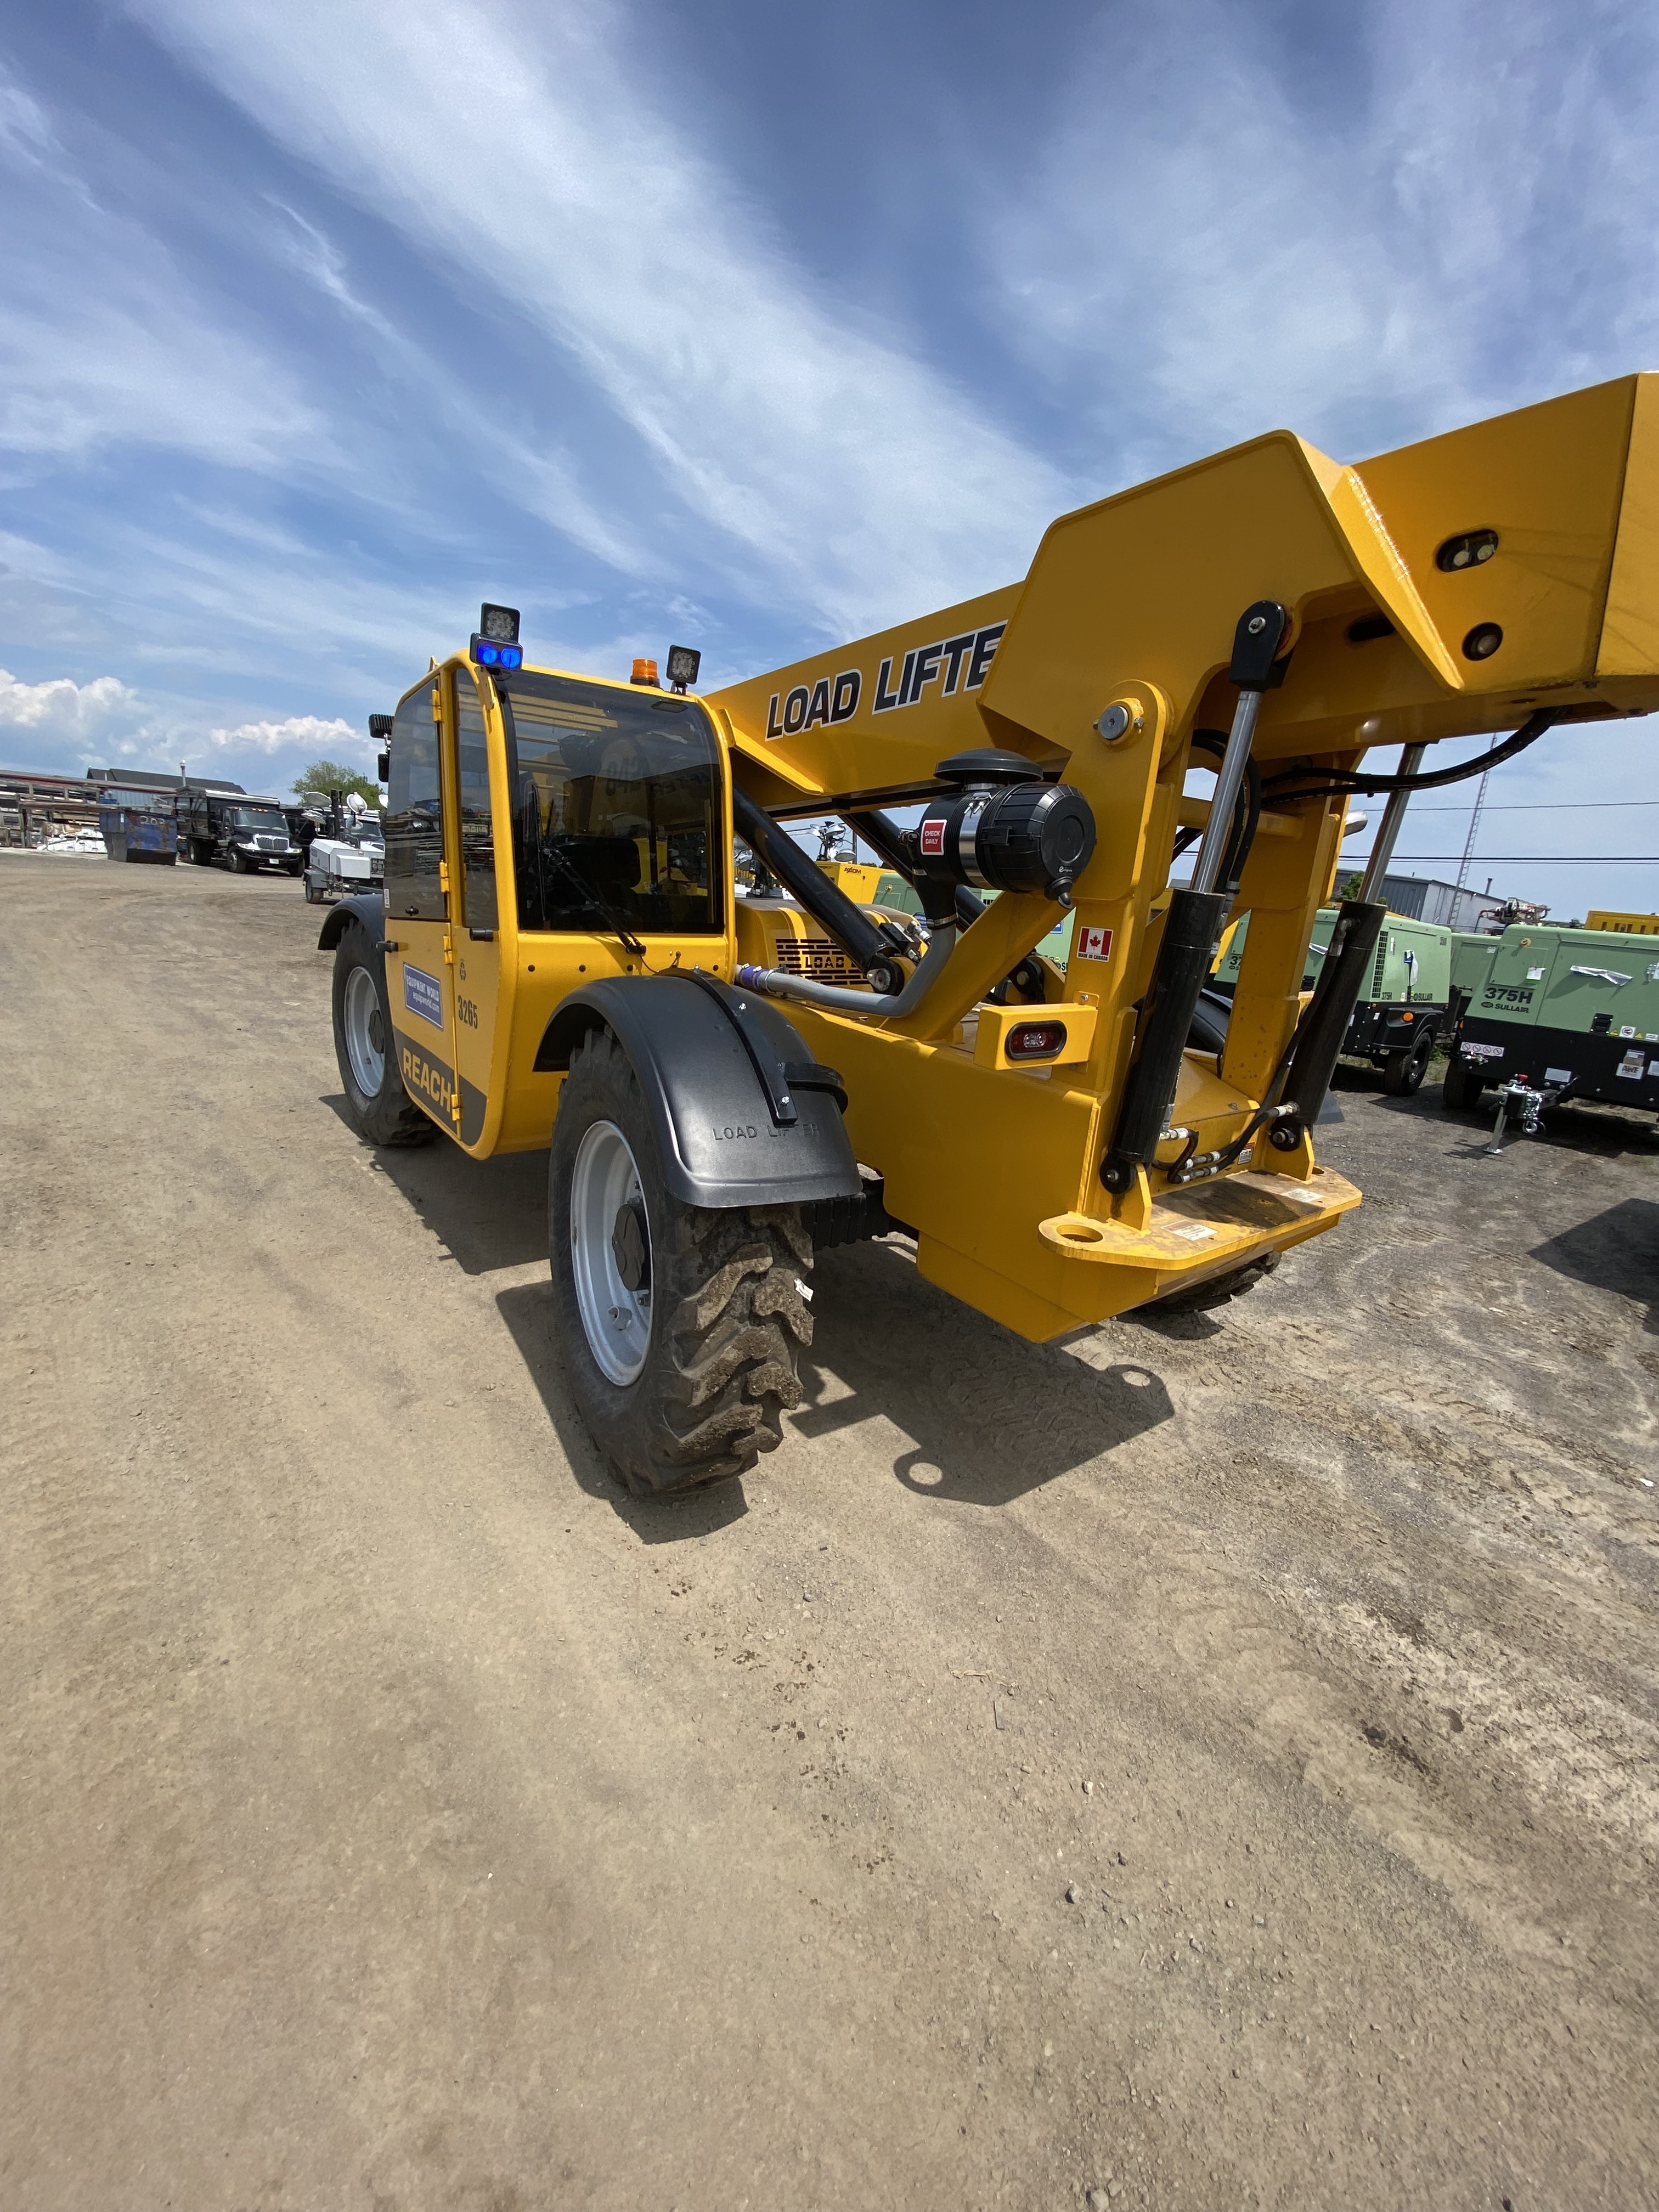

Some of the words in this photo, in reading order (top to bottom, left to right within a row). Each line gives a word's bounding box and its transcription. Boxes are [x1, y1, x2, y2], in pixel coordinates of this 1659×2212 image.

[765, 669, 862, 741] LOAD
[805, 957, 844, 968] LOAD
[426, 985, 439, 1002] WORLD
[1485, 988, 1533, 1004] 375H
[458, 995, 478, 1029] 3265
[1494, 1003, 1530, 1013] SULLAIR
[403, 1047, 452, 1113] REACH
[713, 1126, 757, 1140] LOAD
